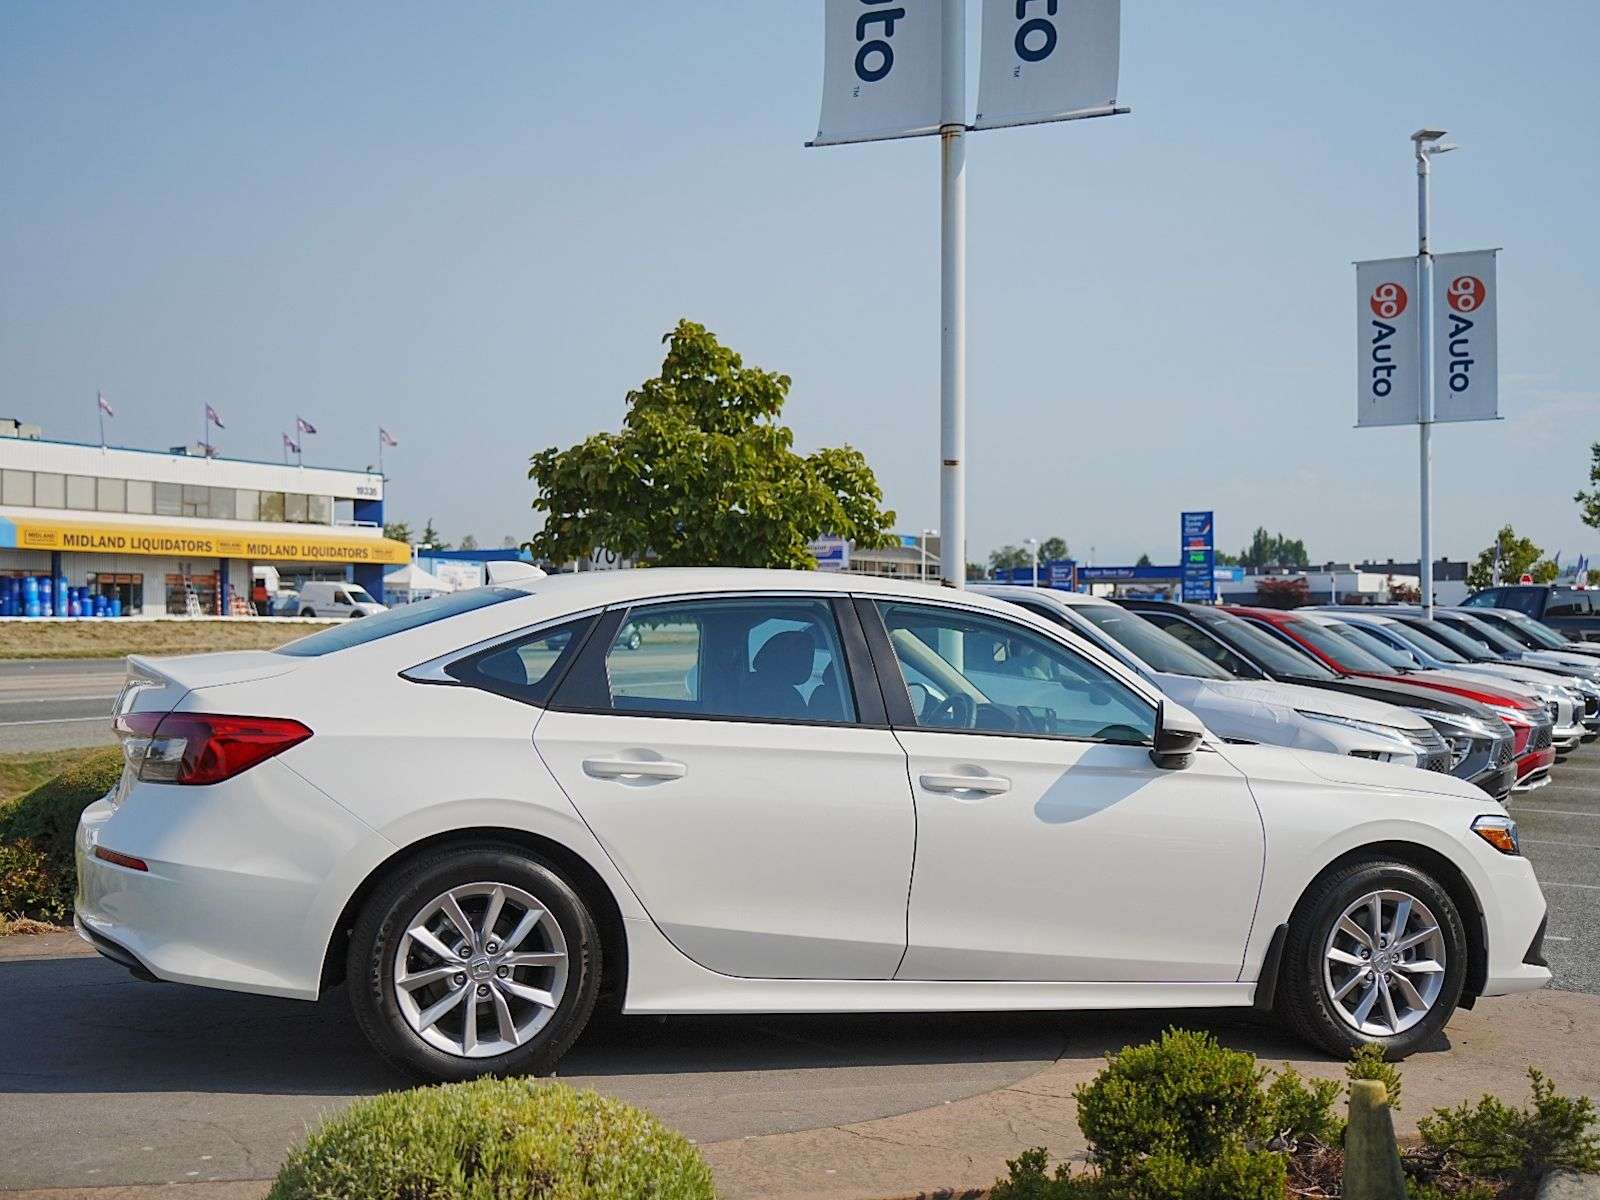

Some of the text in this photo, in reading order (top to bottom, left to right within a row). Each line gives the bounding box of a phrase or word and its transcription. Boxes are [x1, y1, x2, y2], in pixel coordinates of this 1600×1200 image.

[855, 0, 905, 82] to
[1372, 320, 1397, 397] Auto
[1448, 313, 1474, 392] Auto
[63, 533, 126, 549] MIDLAND
[130, 537, 213, 553] LIQUIDATORS
[247, 543, 298, 557] MIDLAND
[301, 545, 369, 559] LIQUIDATORS
